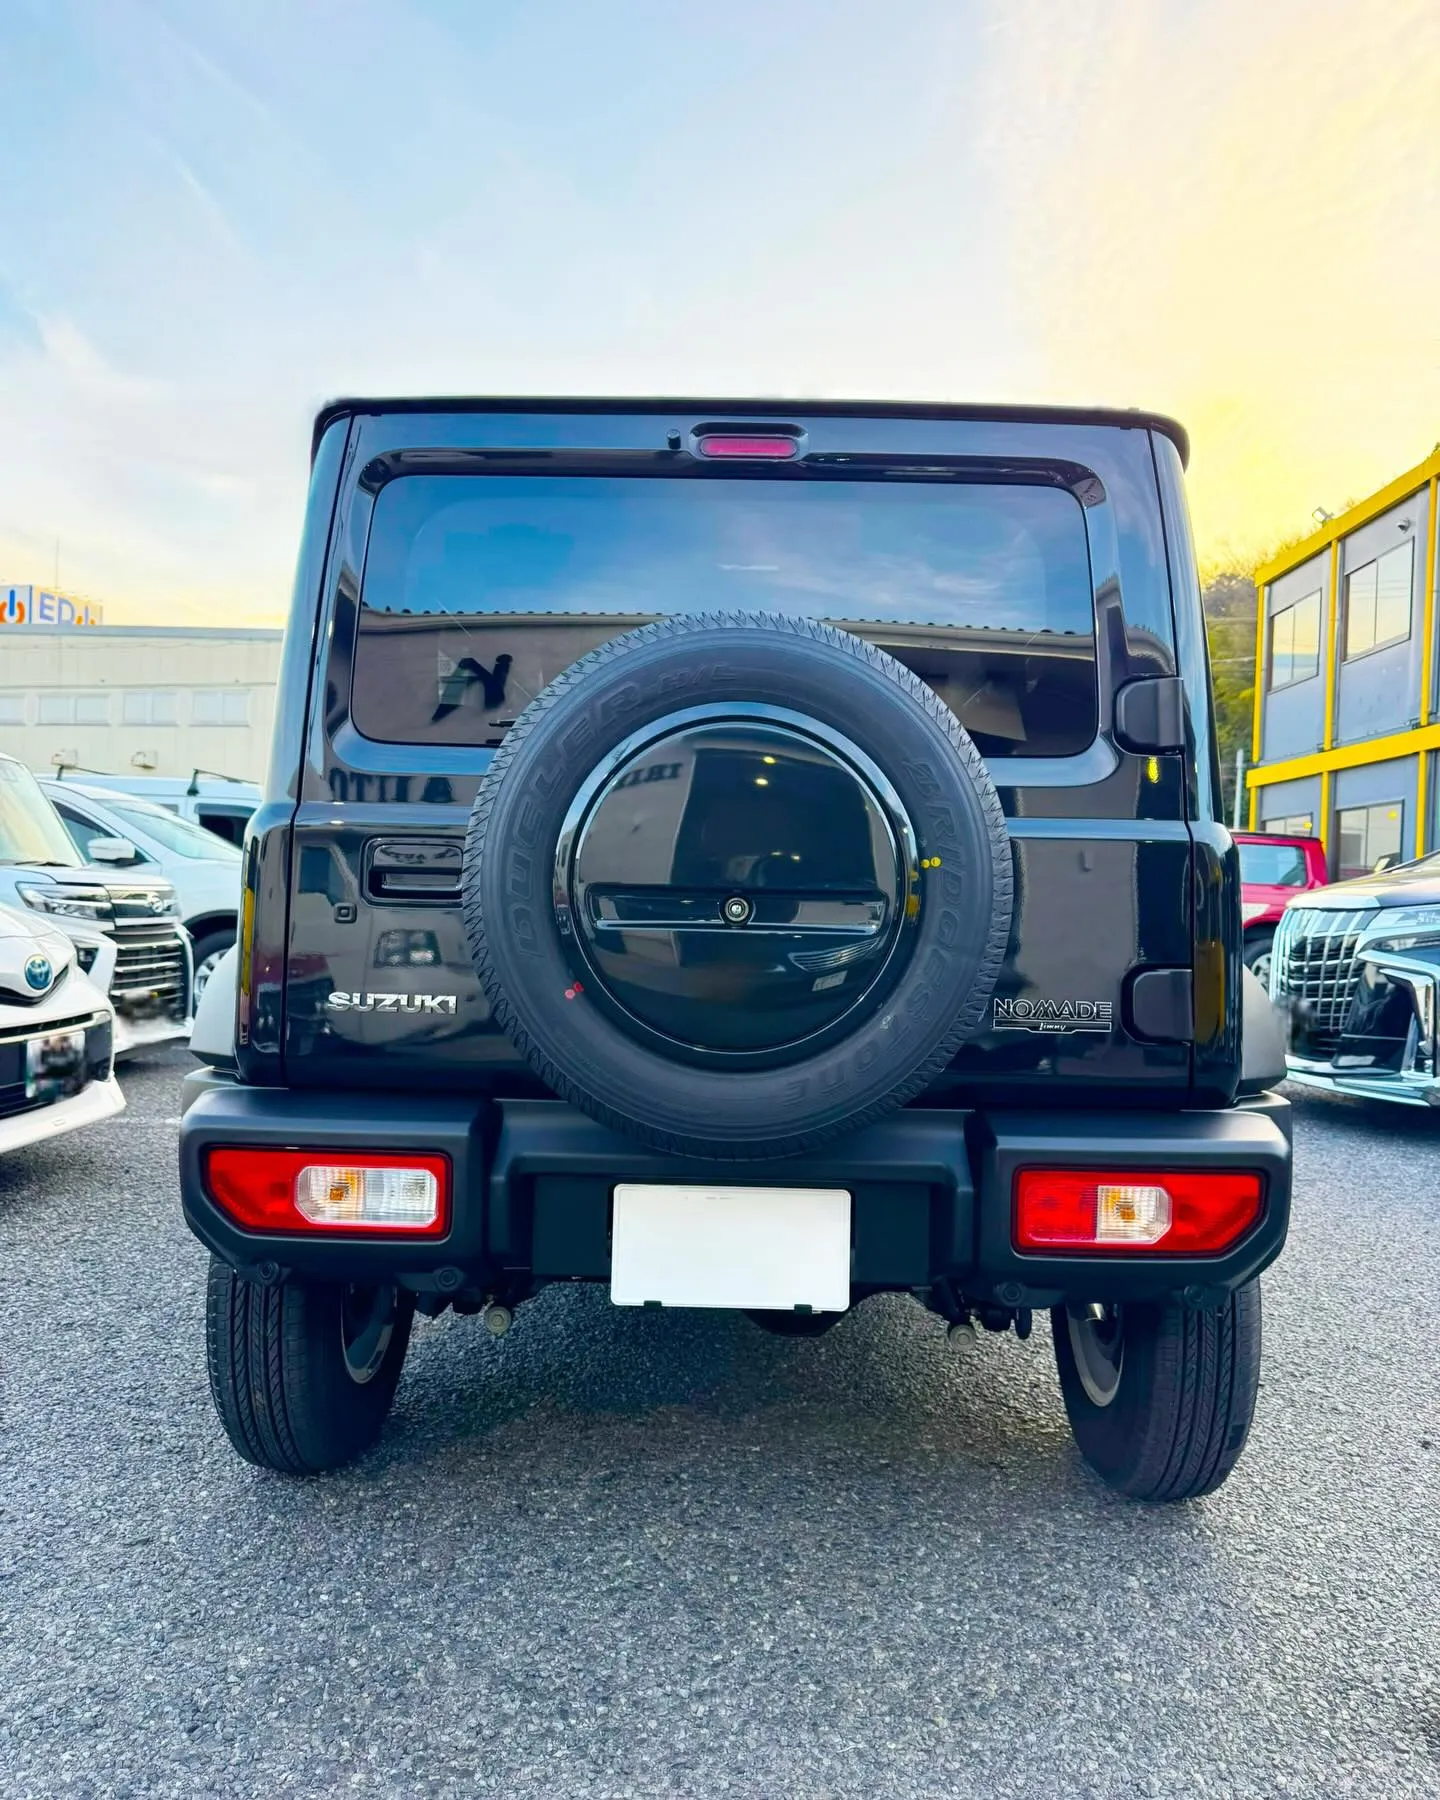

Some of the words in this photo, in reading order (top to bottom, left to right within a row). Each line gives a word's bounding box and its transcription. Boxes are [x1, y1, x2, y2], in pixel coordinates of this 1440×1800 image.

[505, 681, 643, 960] DUELER
[327, 991, 457, 1015] SUZUKI
[784, 759, 964, 1106] BRIDGESTONE
[993, 998, 1113, 1021] NOMADE
